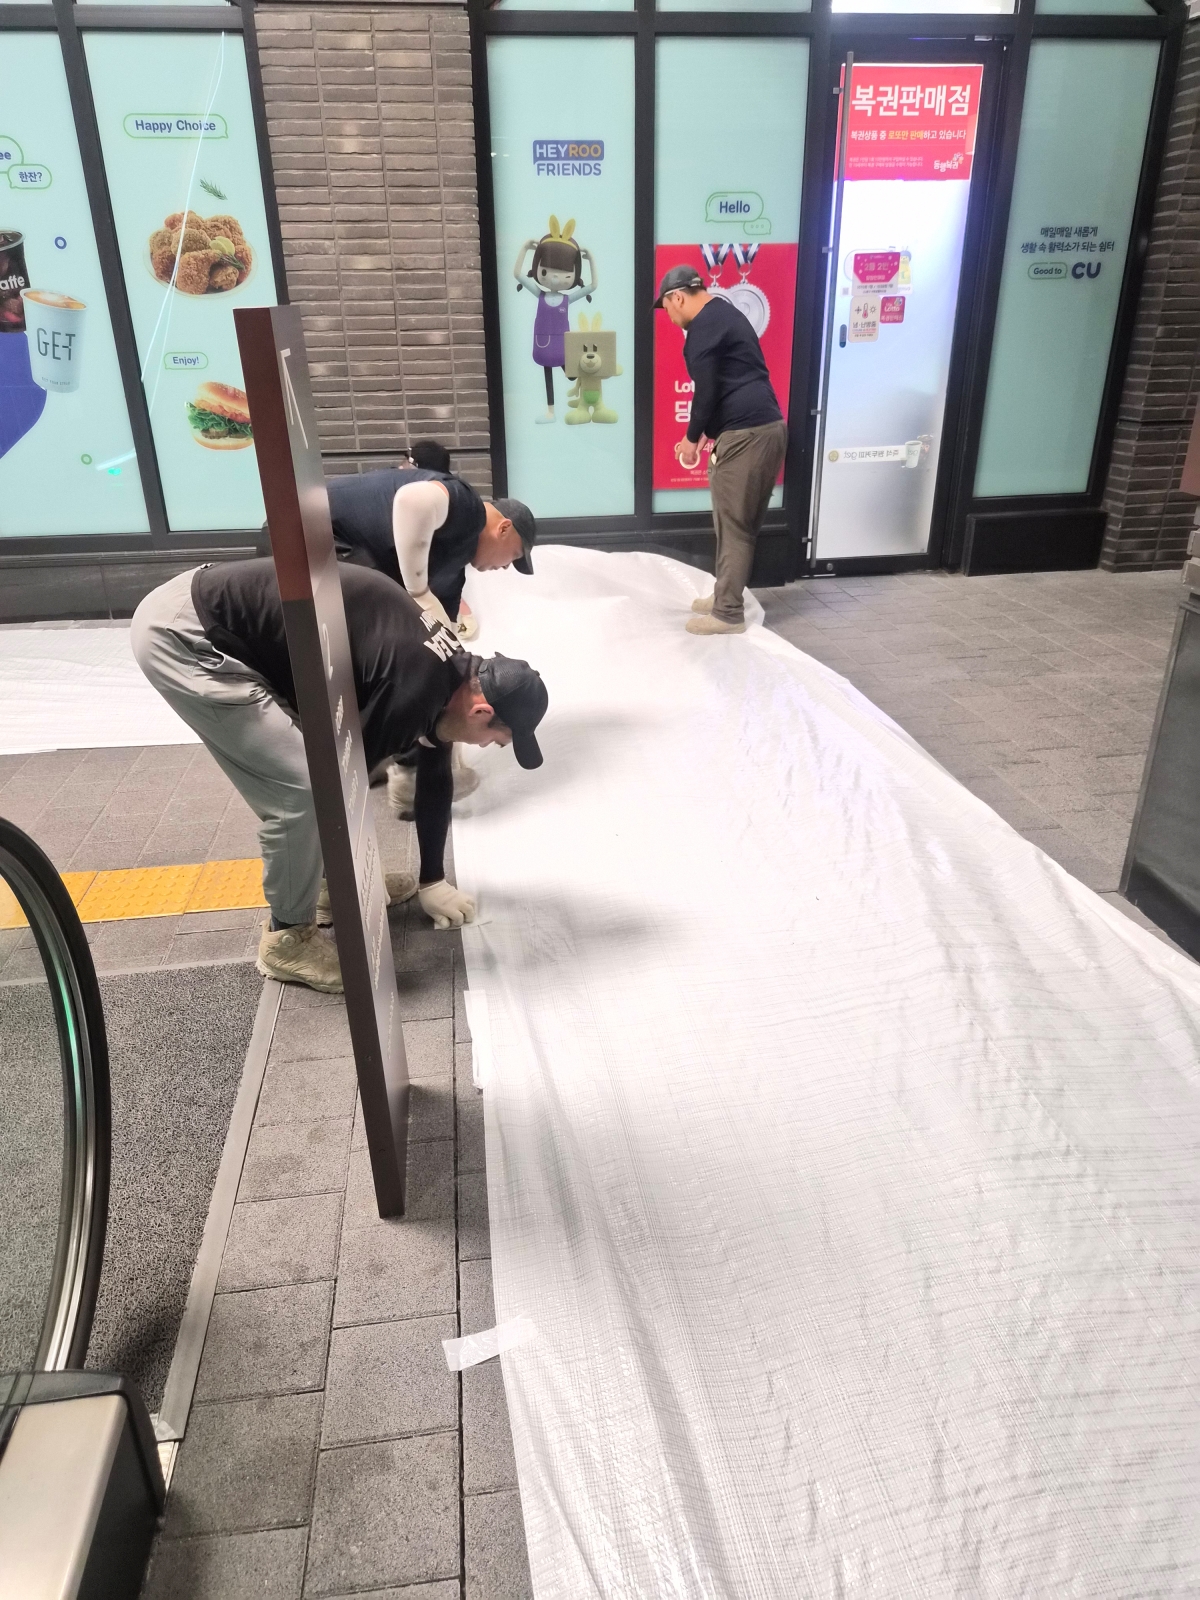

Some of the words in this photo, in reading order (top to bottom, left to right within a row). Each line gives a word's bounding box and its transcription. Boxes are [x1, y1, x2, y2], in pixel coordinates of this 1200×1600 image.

[852, 84, 971, 117] 복권판매점
[135, 119, 173, 133] Happy
[176, 119, 216, 131] Choice
[851, 130, 878, 141] 복권상품
[879, 130, 887, 141] 중
[888, 130, 909, 140] 로또만
[910, 130, 937, 141] 판매하고
[938, 129, 967, 139] 있습니다
[536, 144, 602, 158] HEYROO
[536, 162, 602, 176] FRIENDS
[18, 171, 43, 183] 한잔?
[719, 200, 751, 214] Hello
[1040, 226, 1073, 238] 매일매일
[1073, 226, 1099, 237] 새롭게
[1020, 242, 1037, 253] 생활
[1038, 242, 1047, 253] 속
[1048, 241, 1080, 253] 활력소가
[1081, 241, 1097, 252] 되는
[1098, 241, 1115, 252] 쉼터
[1033, 267, 1053, 275] Good
[1054, 267, 1062, 275] to
[1071, 261, 1102, 280] CU
[0, 274, 25, 291] affe
[36, 327, 76, 361] GET
[172, 356, 200, 366] Enjoy!
